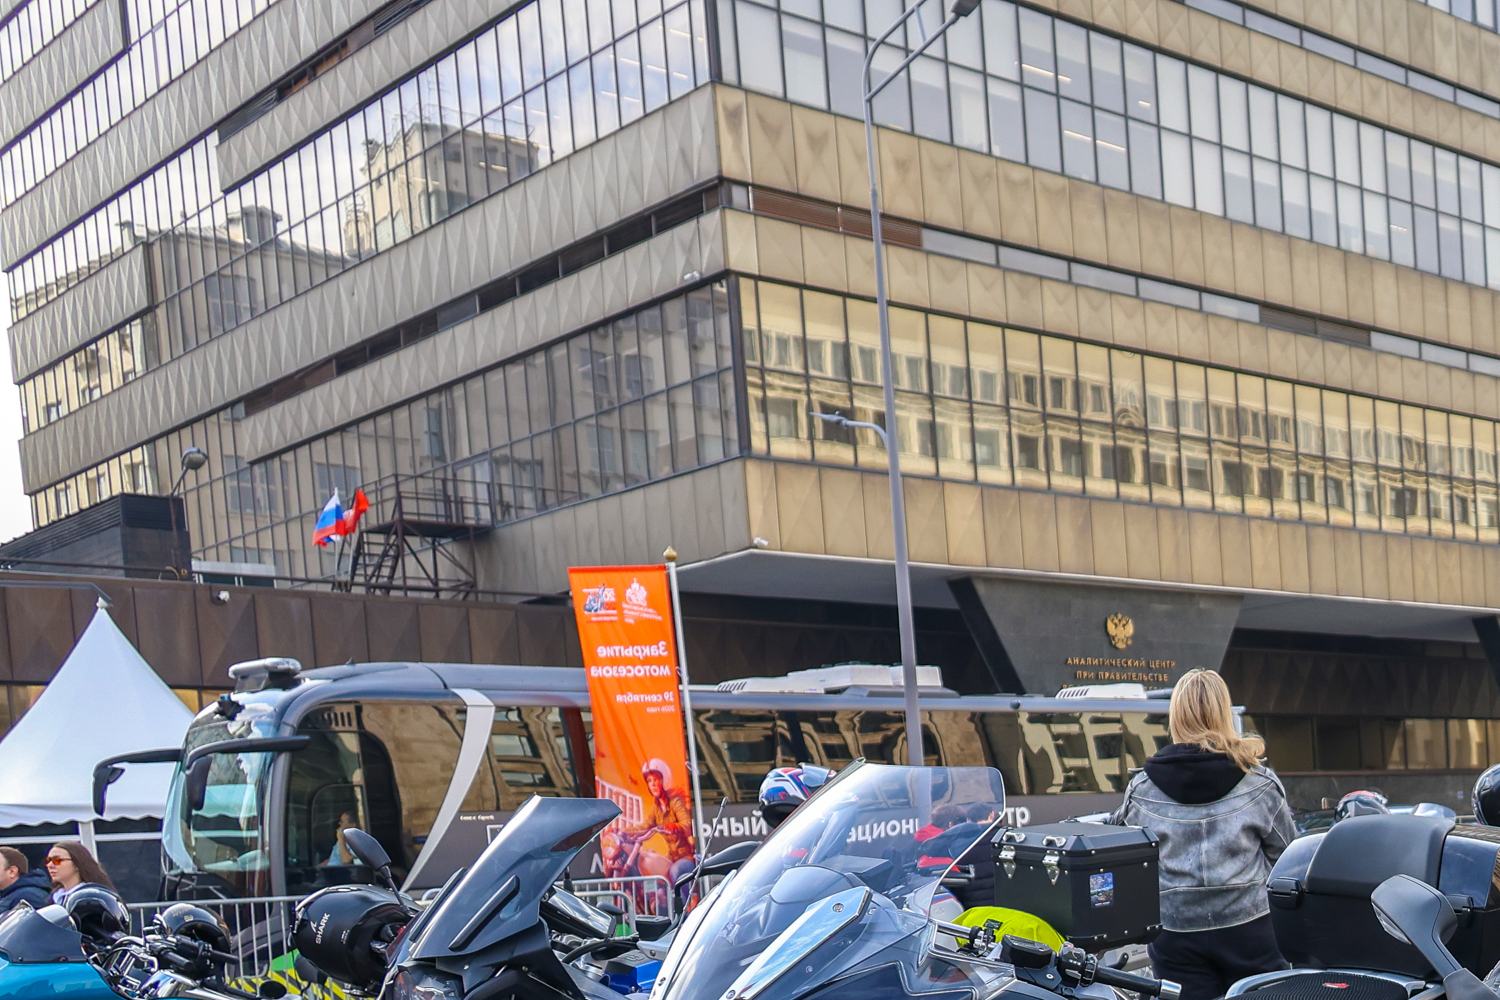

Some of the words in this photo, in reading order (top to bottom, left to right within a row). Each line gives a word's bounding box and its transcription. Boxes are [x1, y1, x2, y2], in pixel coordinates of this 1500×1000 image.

[1066, 657, 1146, 668] АНАЛИТИЧЕСКИЙ
[1149, 660, 1176, 669] ЦЕНТР
[1076, 670, 1095, 679] ПРИ
[1098, 671, 1169, 682] ПРАВИТЕЛЬСТВЕ
[692, 810, 768, 838] ьный
[315, 912, 331, 945] SHARK
